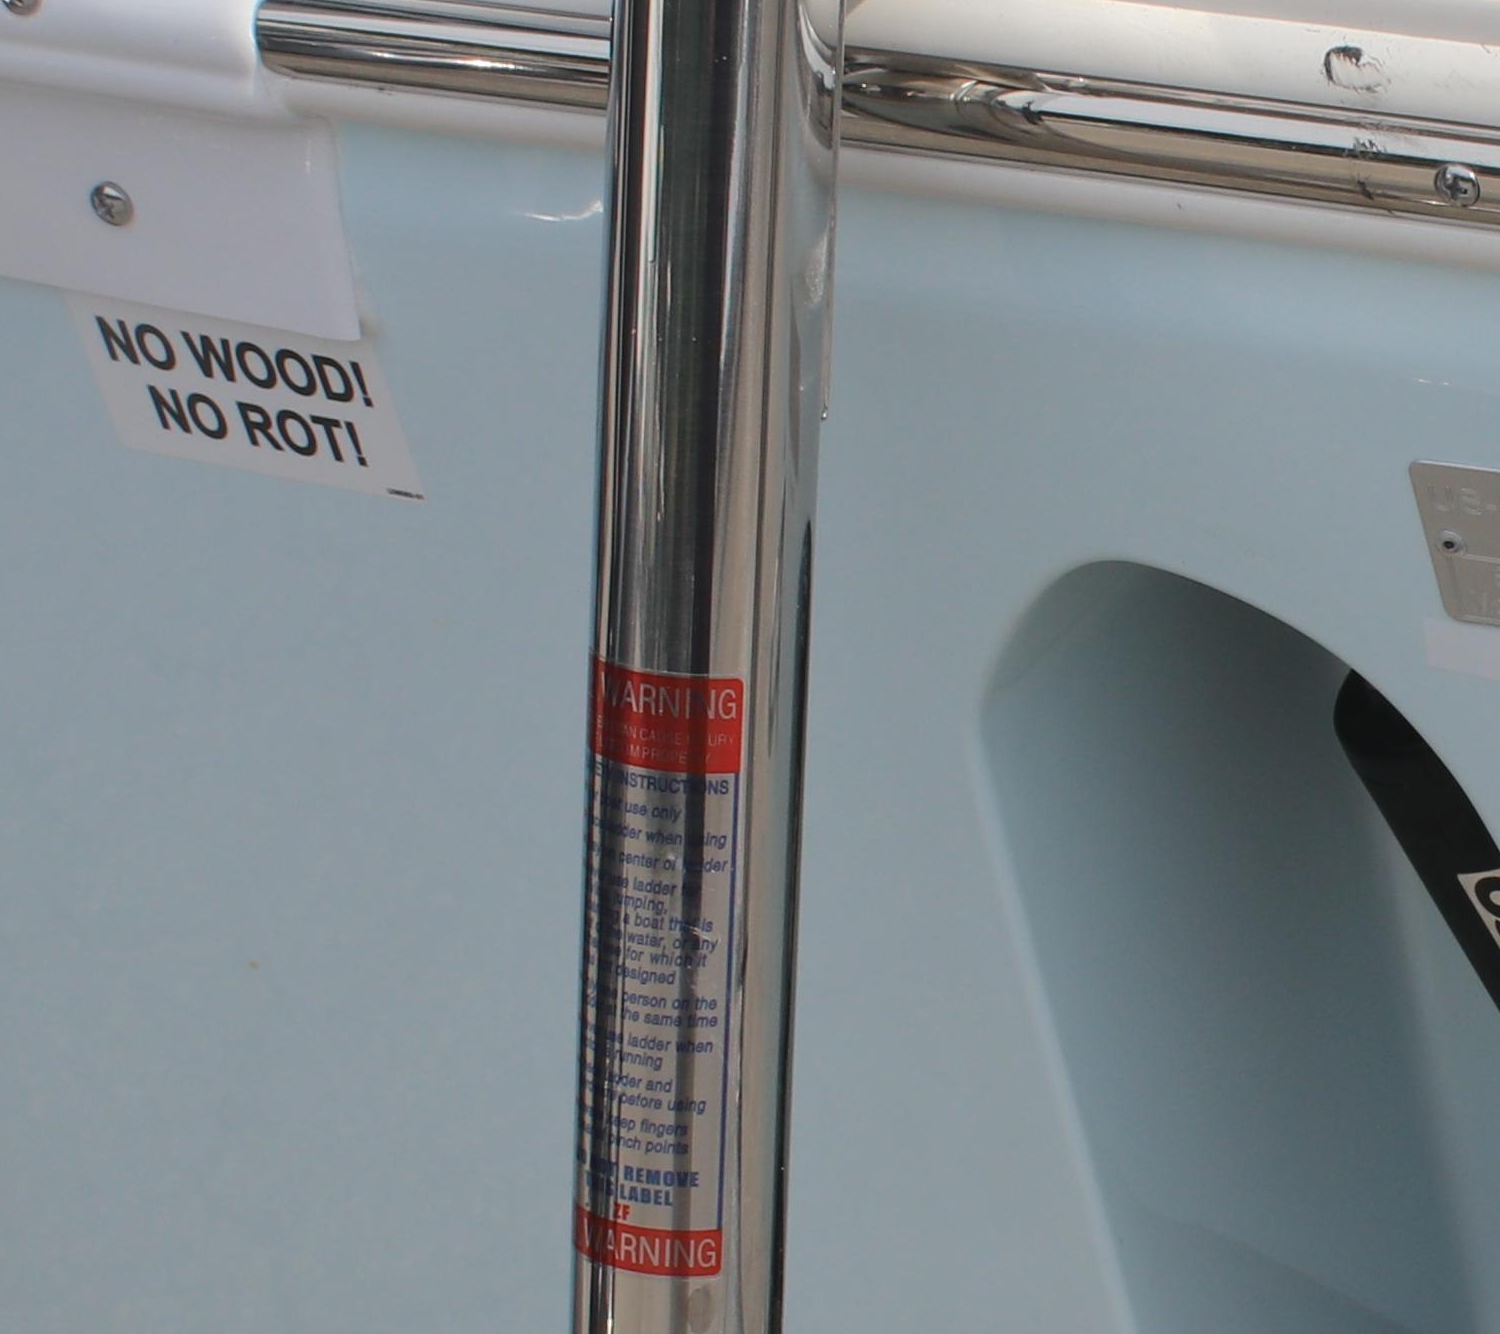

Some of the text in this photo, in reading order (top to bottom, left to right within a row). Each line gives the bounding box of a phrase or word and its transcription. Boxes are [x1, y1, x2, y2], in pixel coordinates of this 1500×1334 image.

[95, 315, 374, 408] NO WOOD!
[147, 384, 369, 467] NO ROT!
[601, 670, 737, 720] WARNING
[617, 769, 729, 796] NSTRUCTNS
[624, 803, 682, 823] use only
[646, 828, 683, 846] when
[619, 851, 659, 869] center
[633, 877, 677, 896] ladder
[634, 913, 665, 930] boat
[701, 917, 714, 934] is
[627, 931, 667, 954] water,
[626, 946, 644, 961] for
[649, 950, 693, 967] which
[615, 964, 677, 985] designed
[622, 991, 667, 1010] person
[671, 998, 690, 1011] on
[694, 996, 718, 1011] the
[643, 1012, 683, 1027] same
[686, 1013, 719, 1028] time
[627, 1032, 672, 1052] ladder
[675, 1040, 714, 1054] when
[613, 1049, 663, 1071] running
[645, 1078, 673, 1093] and
[619, 1091, 707, 1116] before using
[640, 1117, 689, 1137] fingers
[608, 1133, 690, 1155] pinch points
[623, 1164, 701, 1188] REMOVE
[619, 1183, 674, 1207] LABEL
[583, 1217, 717, 1268] WARNING
